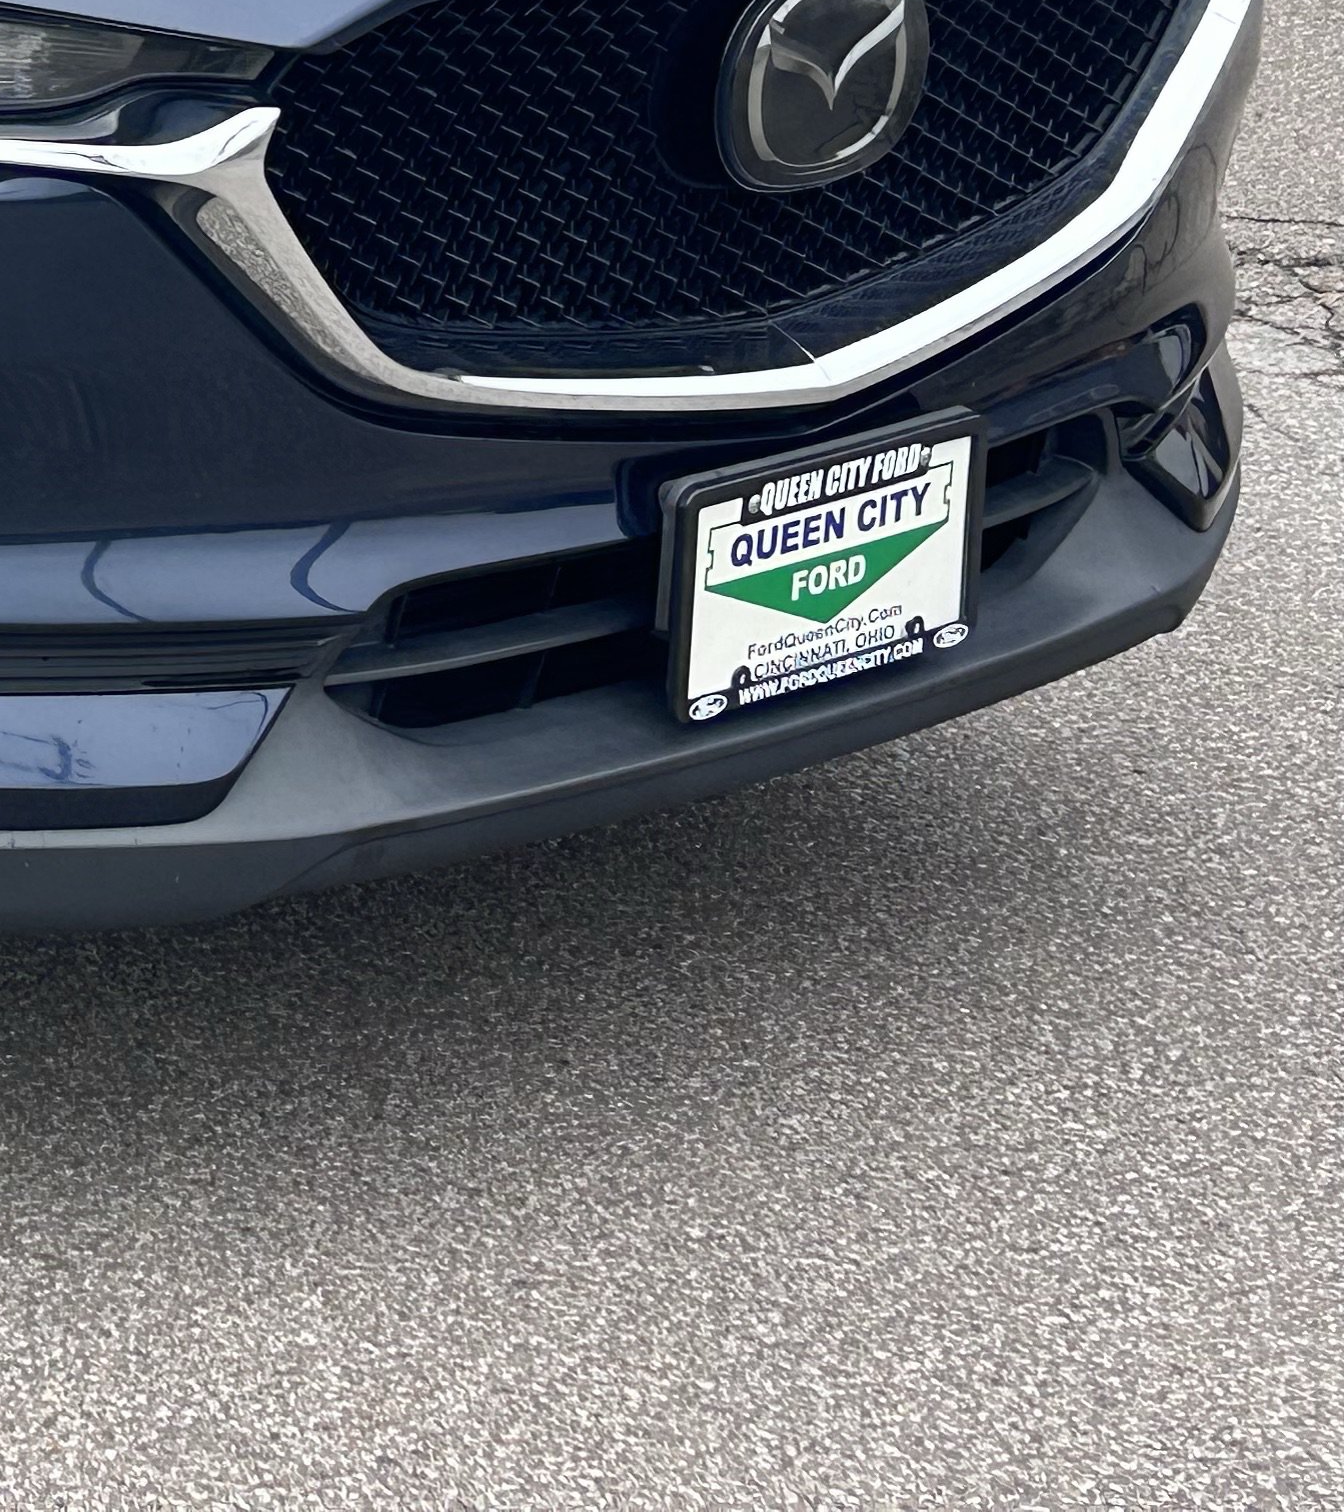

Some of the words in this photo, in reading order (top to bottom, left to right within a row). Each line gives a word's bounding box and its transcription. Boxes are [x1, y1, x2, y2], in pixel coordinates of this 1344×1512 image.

[760, 468, 824, 516] QUEEN
[826, 455, 873, 497] CITY
[871, 443, 922, 484] FORD
[730, 505, 846, 567] QUEEN
[857, 481, 932, 533] CITY
[791, 554, 866, 602] FORD
[855, 624, 896, 650] OHIO
